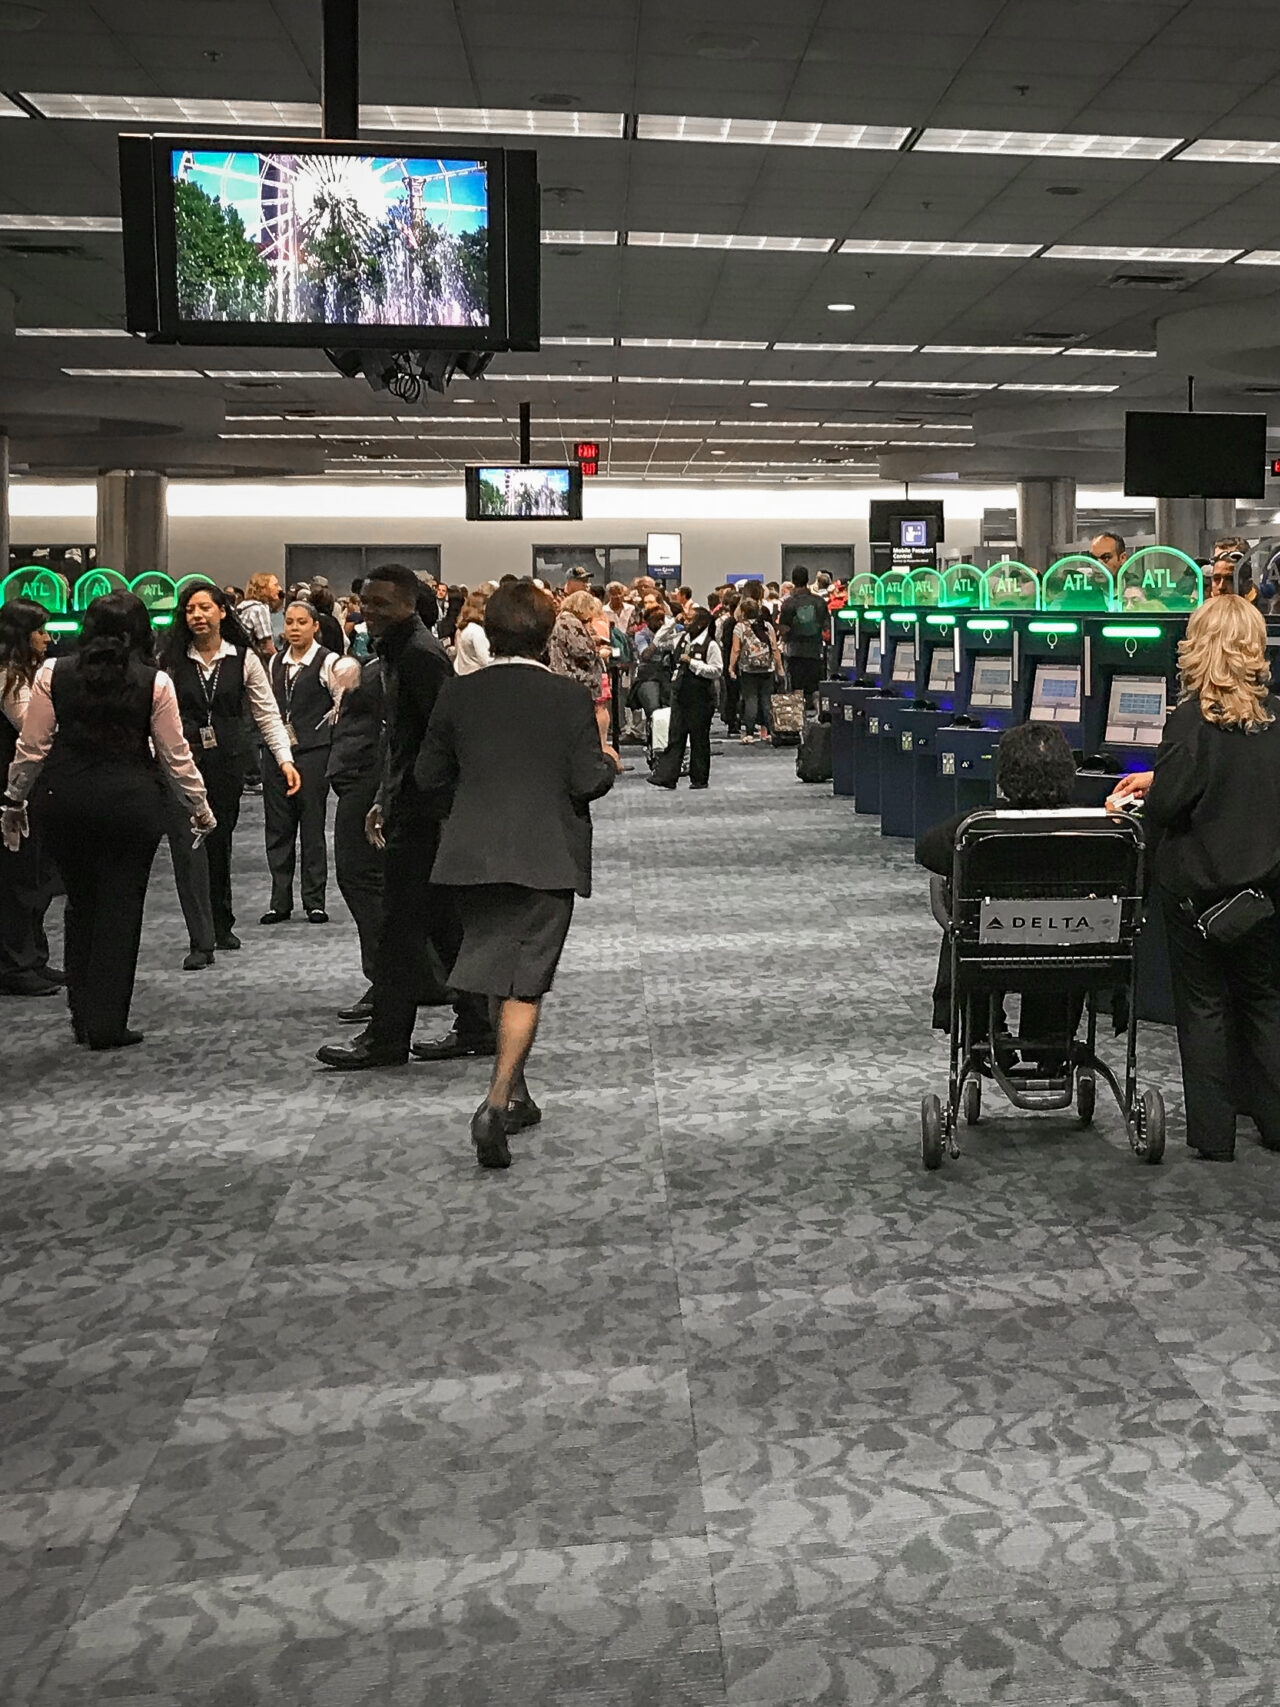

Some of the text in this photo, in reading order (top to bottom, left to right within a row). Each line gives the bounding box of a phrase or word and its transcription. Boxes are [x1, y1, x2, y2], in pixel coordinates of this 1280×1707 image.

[952, 578, 974, 592] ATL
[997, 577, 1022, 593] ATL
[1063, 574, 1093, 591] ATL
[1142, 568, 1177, 589] ATL
[21, 582, 50, 597] ATL
[144, 583, 164, 596] ATL
[859, 583, 874, 595] ATL
[915, 580, 933, 593] ATL
[1012, 917, 1090, 929] DELTA
